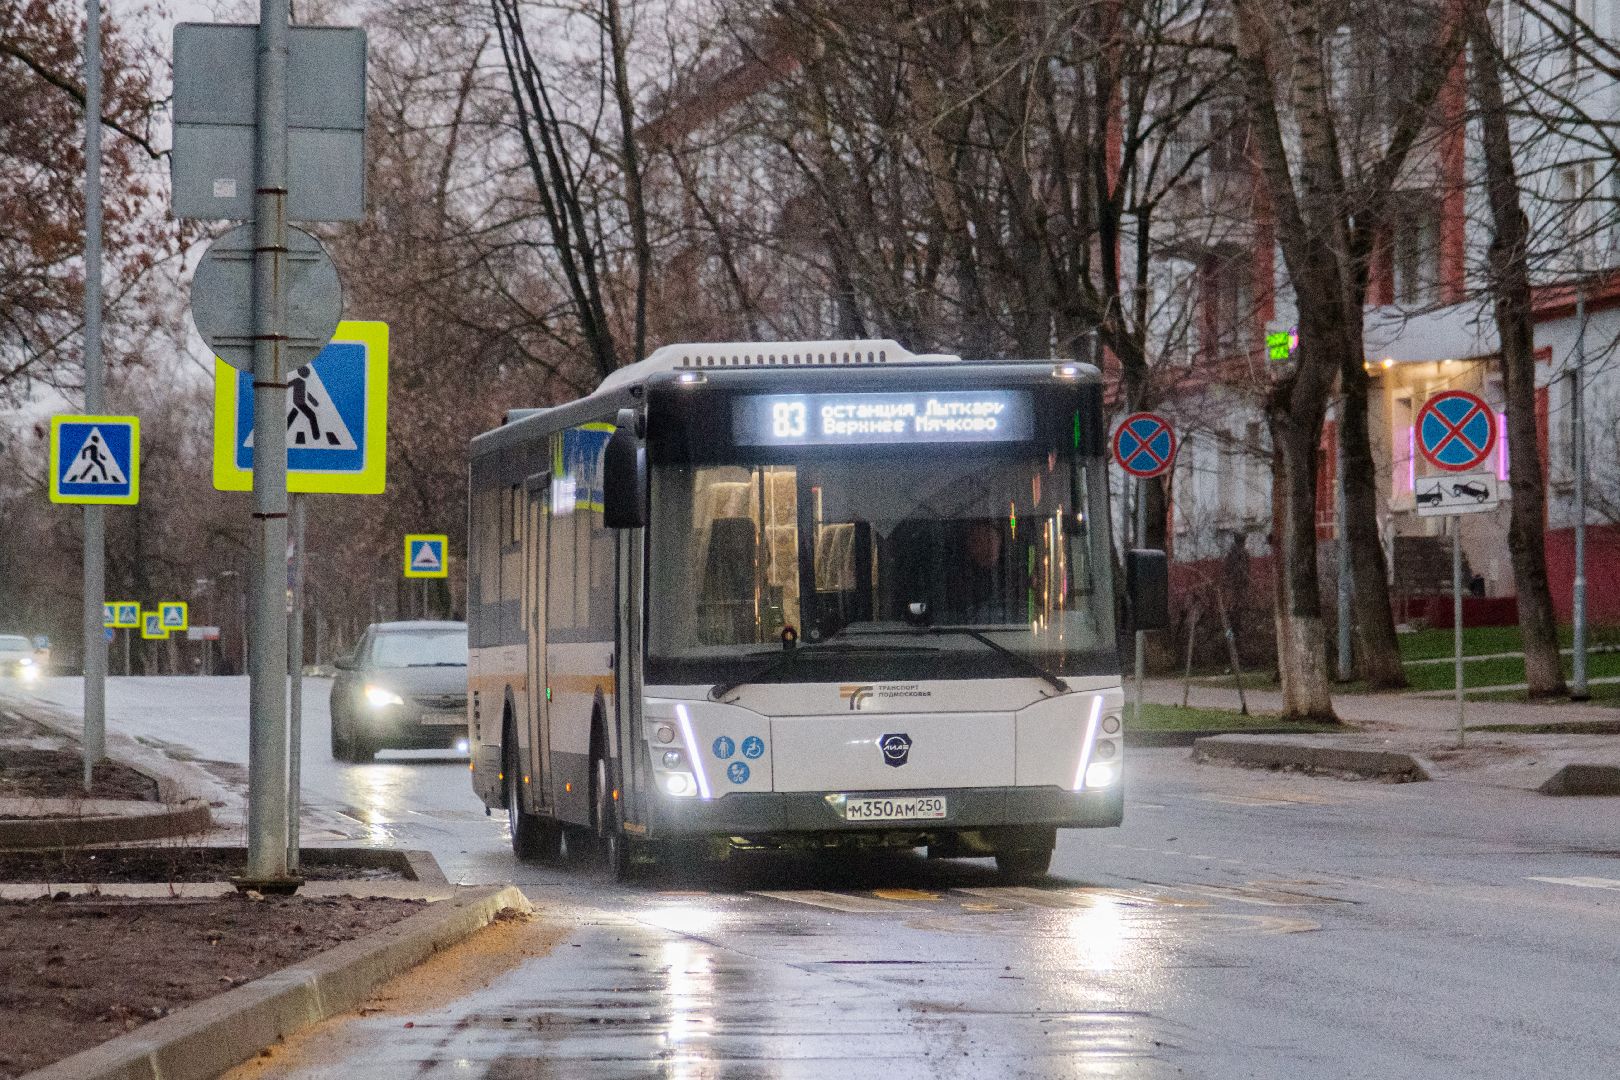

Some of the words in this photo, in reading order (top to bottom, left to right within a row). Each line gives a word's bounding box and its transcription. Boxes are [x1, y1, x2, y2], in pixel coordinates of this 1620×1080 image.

[773, 402, 807, 437] 83
[823, 418, 904, 435] Верхнее
[915, 416, 997, 432] Мячково
[918, 799, 942, 811] 250
